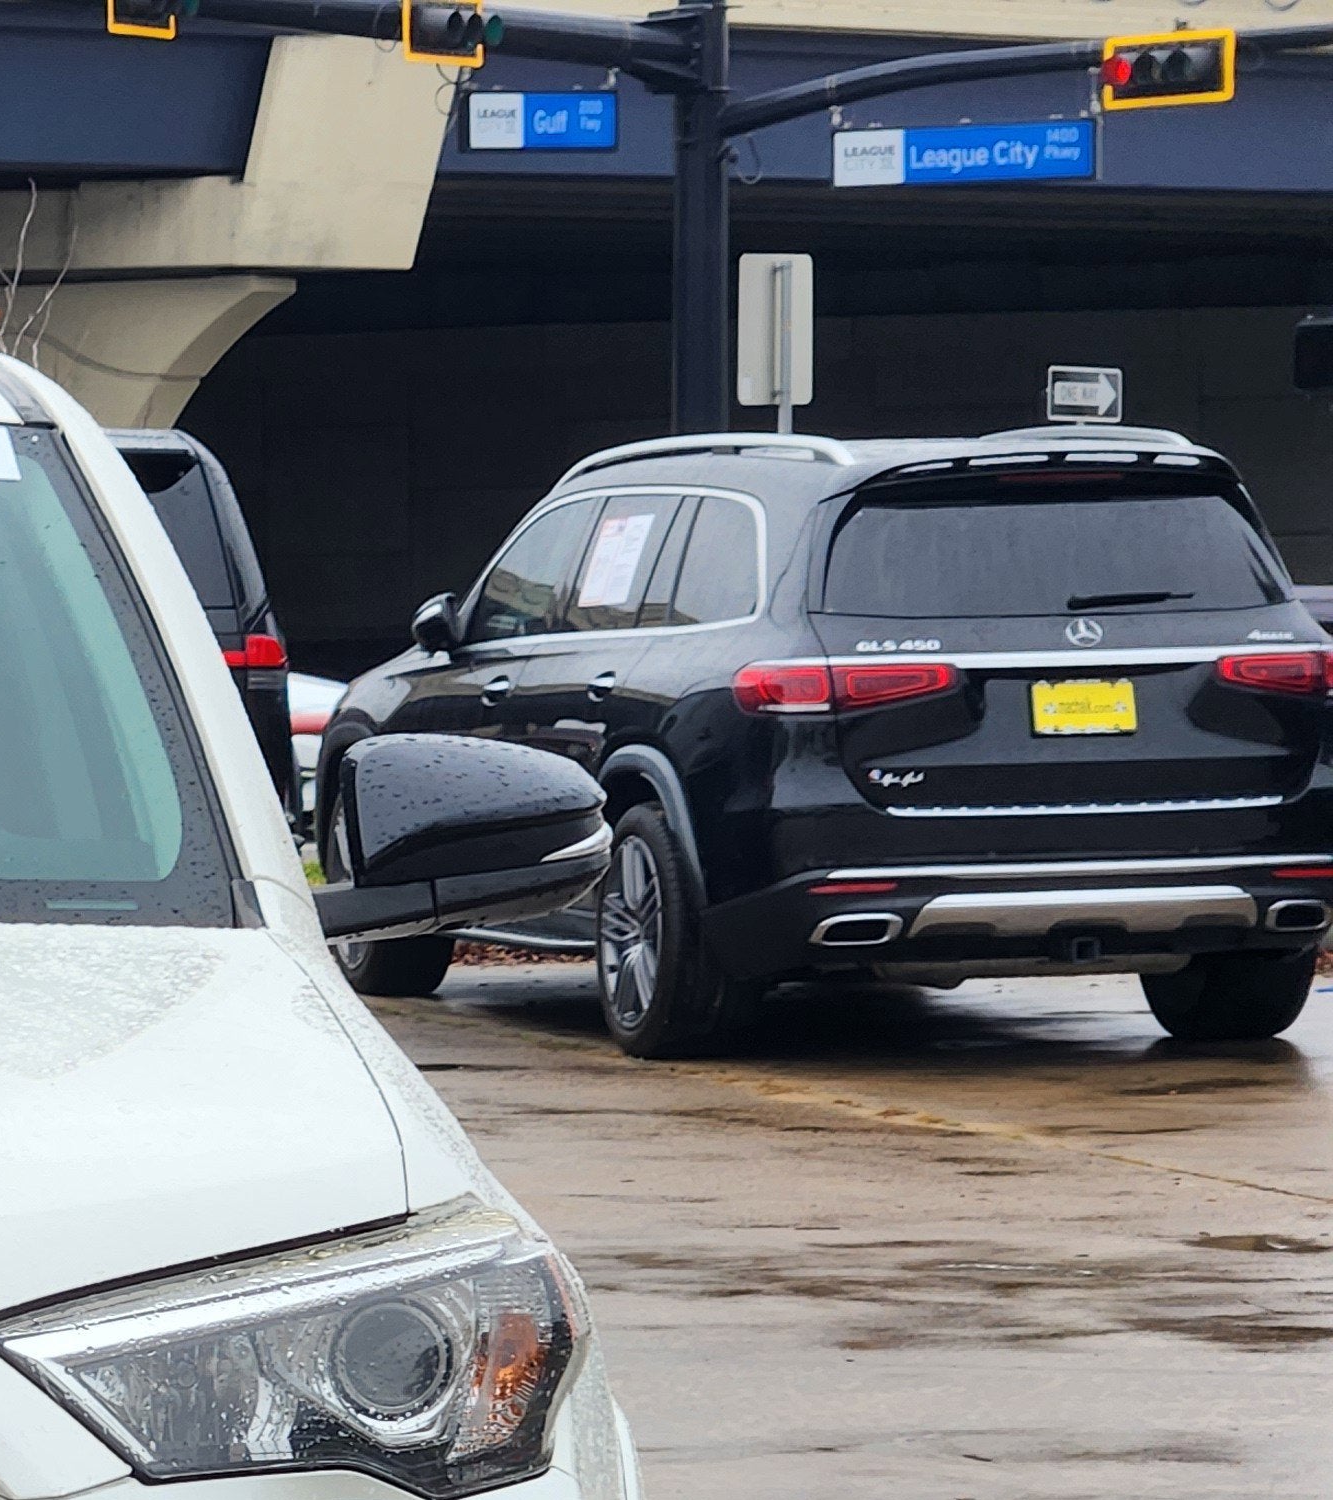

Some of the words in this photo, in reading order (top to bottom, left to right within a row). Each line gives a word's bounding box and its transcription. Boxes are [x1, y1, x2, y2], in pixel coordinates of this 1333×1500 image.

[533, 109, 569, 135] Gulf
[844, 145, 896, 158] LEAGUE
[910, 145, 989, 174] League
[993, 140, 1039, 170] City
